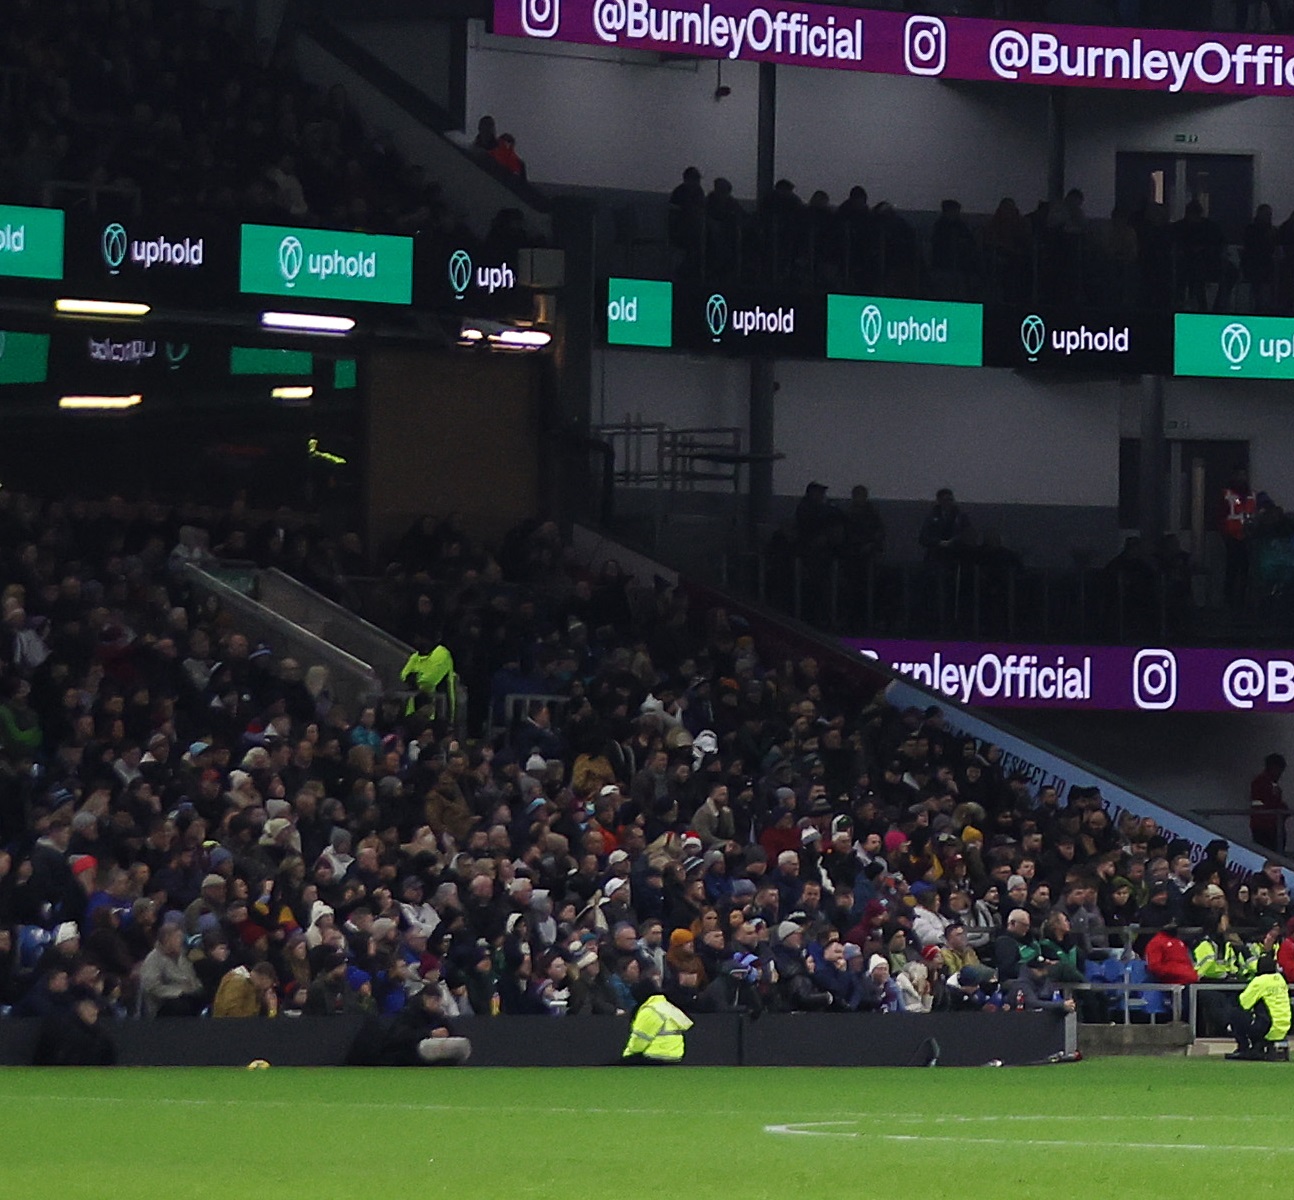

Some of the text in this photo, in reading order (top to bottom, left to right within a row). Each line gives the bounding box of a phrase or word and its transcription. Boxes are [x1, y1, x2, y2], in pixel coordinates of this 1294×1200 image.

[133, 235, 203, 268] uphold
[308, 249, 376, 280] uphold
[732, 305, 794, 336] uphold
[887, 316, 947, 346] uphold
[1052, 325, 1129, 355] uphold
